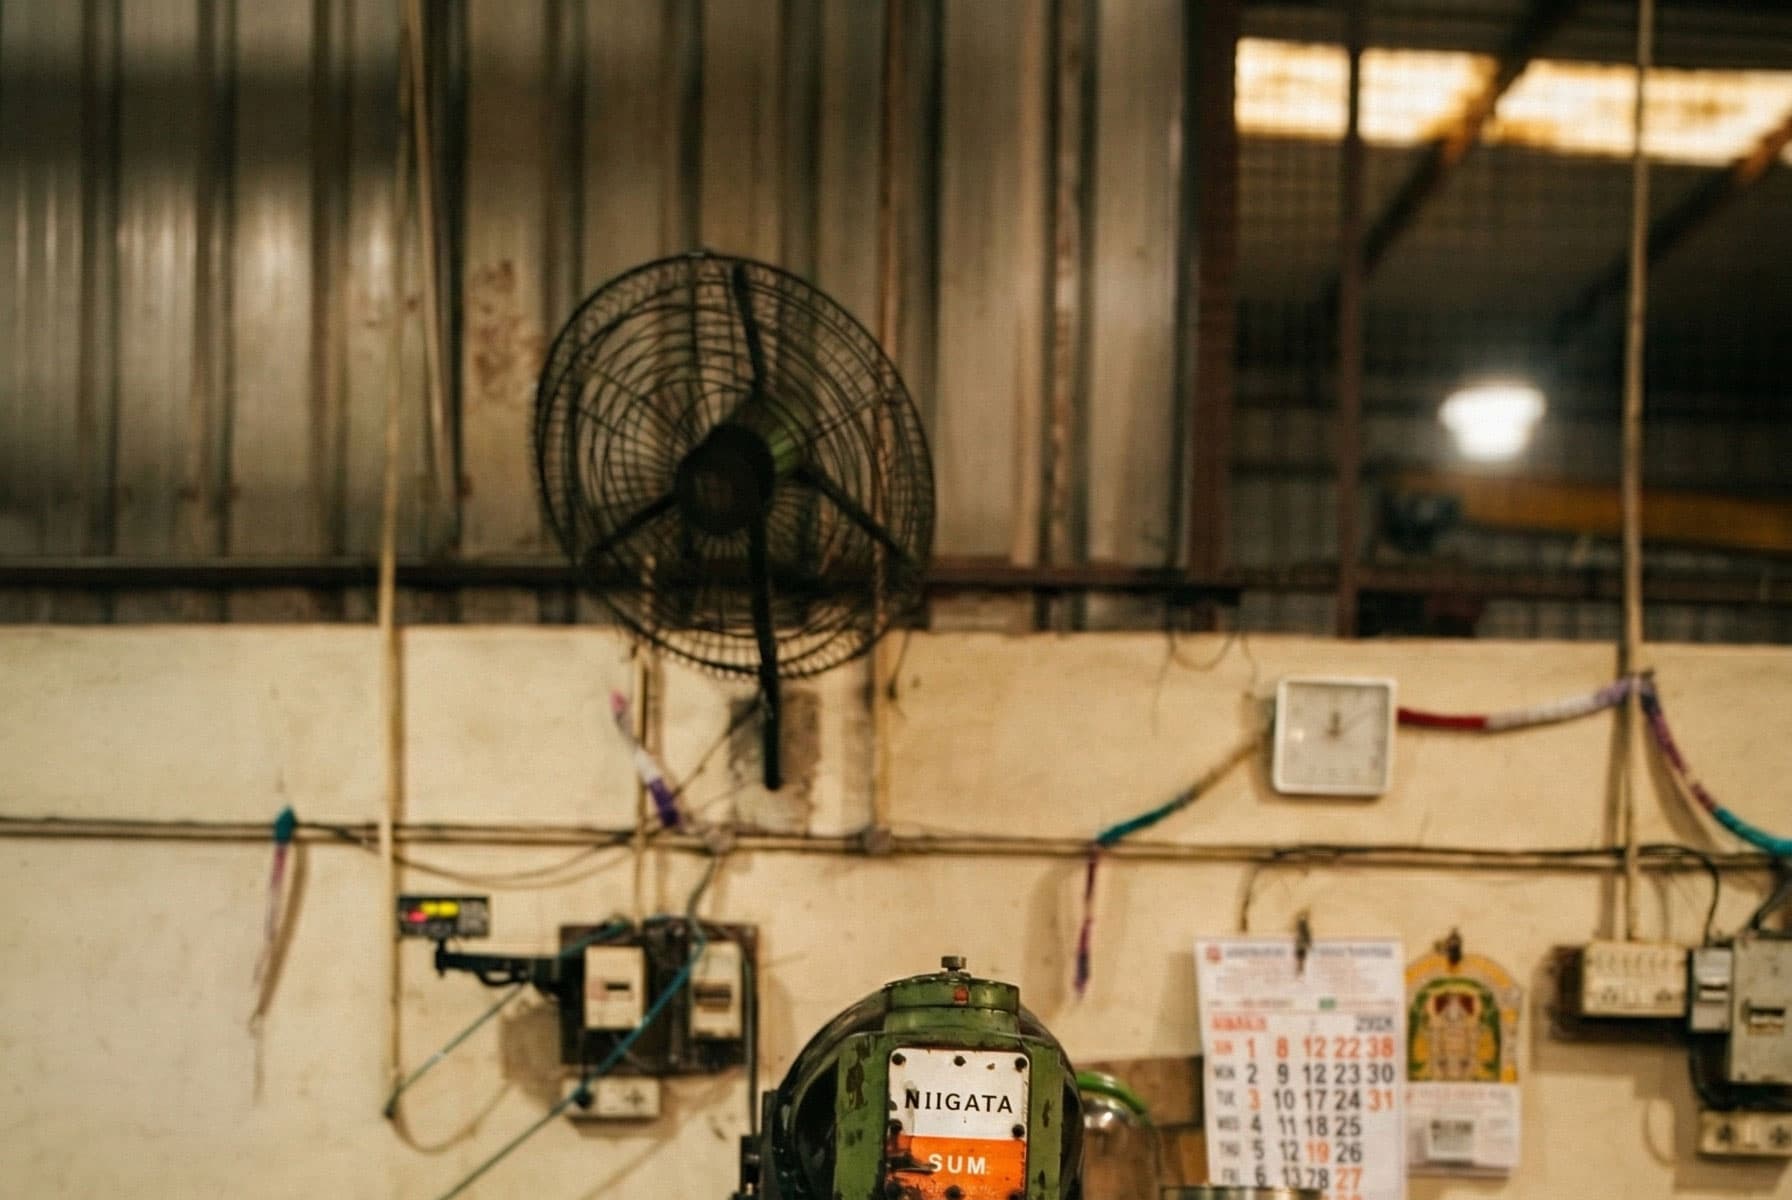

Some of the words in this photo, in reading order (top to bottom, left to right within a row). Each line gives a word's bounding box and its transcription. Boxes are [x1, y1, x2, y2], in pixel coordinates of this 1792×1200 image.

[1333, 1037, 1360, 1058] 22
[1246, 1063, 1257, 1084] 2
[1277, 1063, 1289, 1085] 9
[1334, 1063, 1360, 1085] 23
[1367, 1063, 1394, 1085] 30
[904, 1088, 1013, 1114] NIIGATA
[1248, 1089, 1261, 1110] 3
[1273, 1089, 1295, 1110] 10
[1304, 1089, 1327, 1110] 17
[1335, 1089, 1360, 1110] 24
[1367, 1089, 1393, 1110] 31
[1250, 1115, 1262, 1133] 4
[1278, 1116, 1297, 1135] 11
[1305, 1115, 1328, 1136] 18
[1335, 1115, 1361, 1136] 25
[1253, 1140, 1264, 1160] 5
[1279, 1140, 1299, 1162] 12
[1336, 1141, 1362, 1162] 26
[928, 1153, 986, 1175] SUM
[1335, 1167, 1362, 1189] 27
